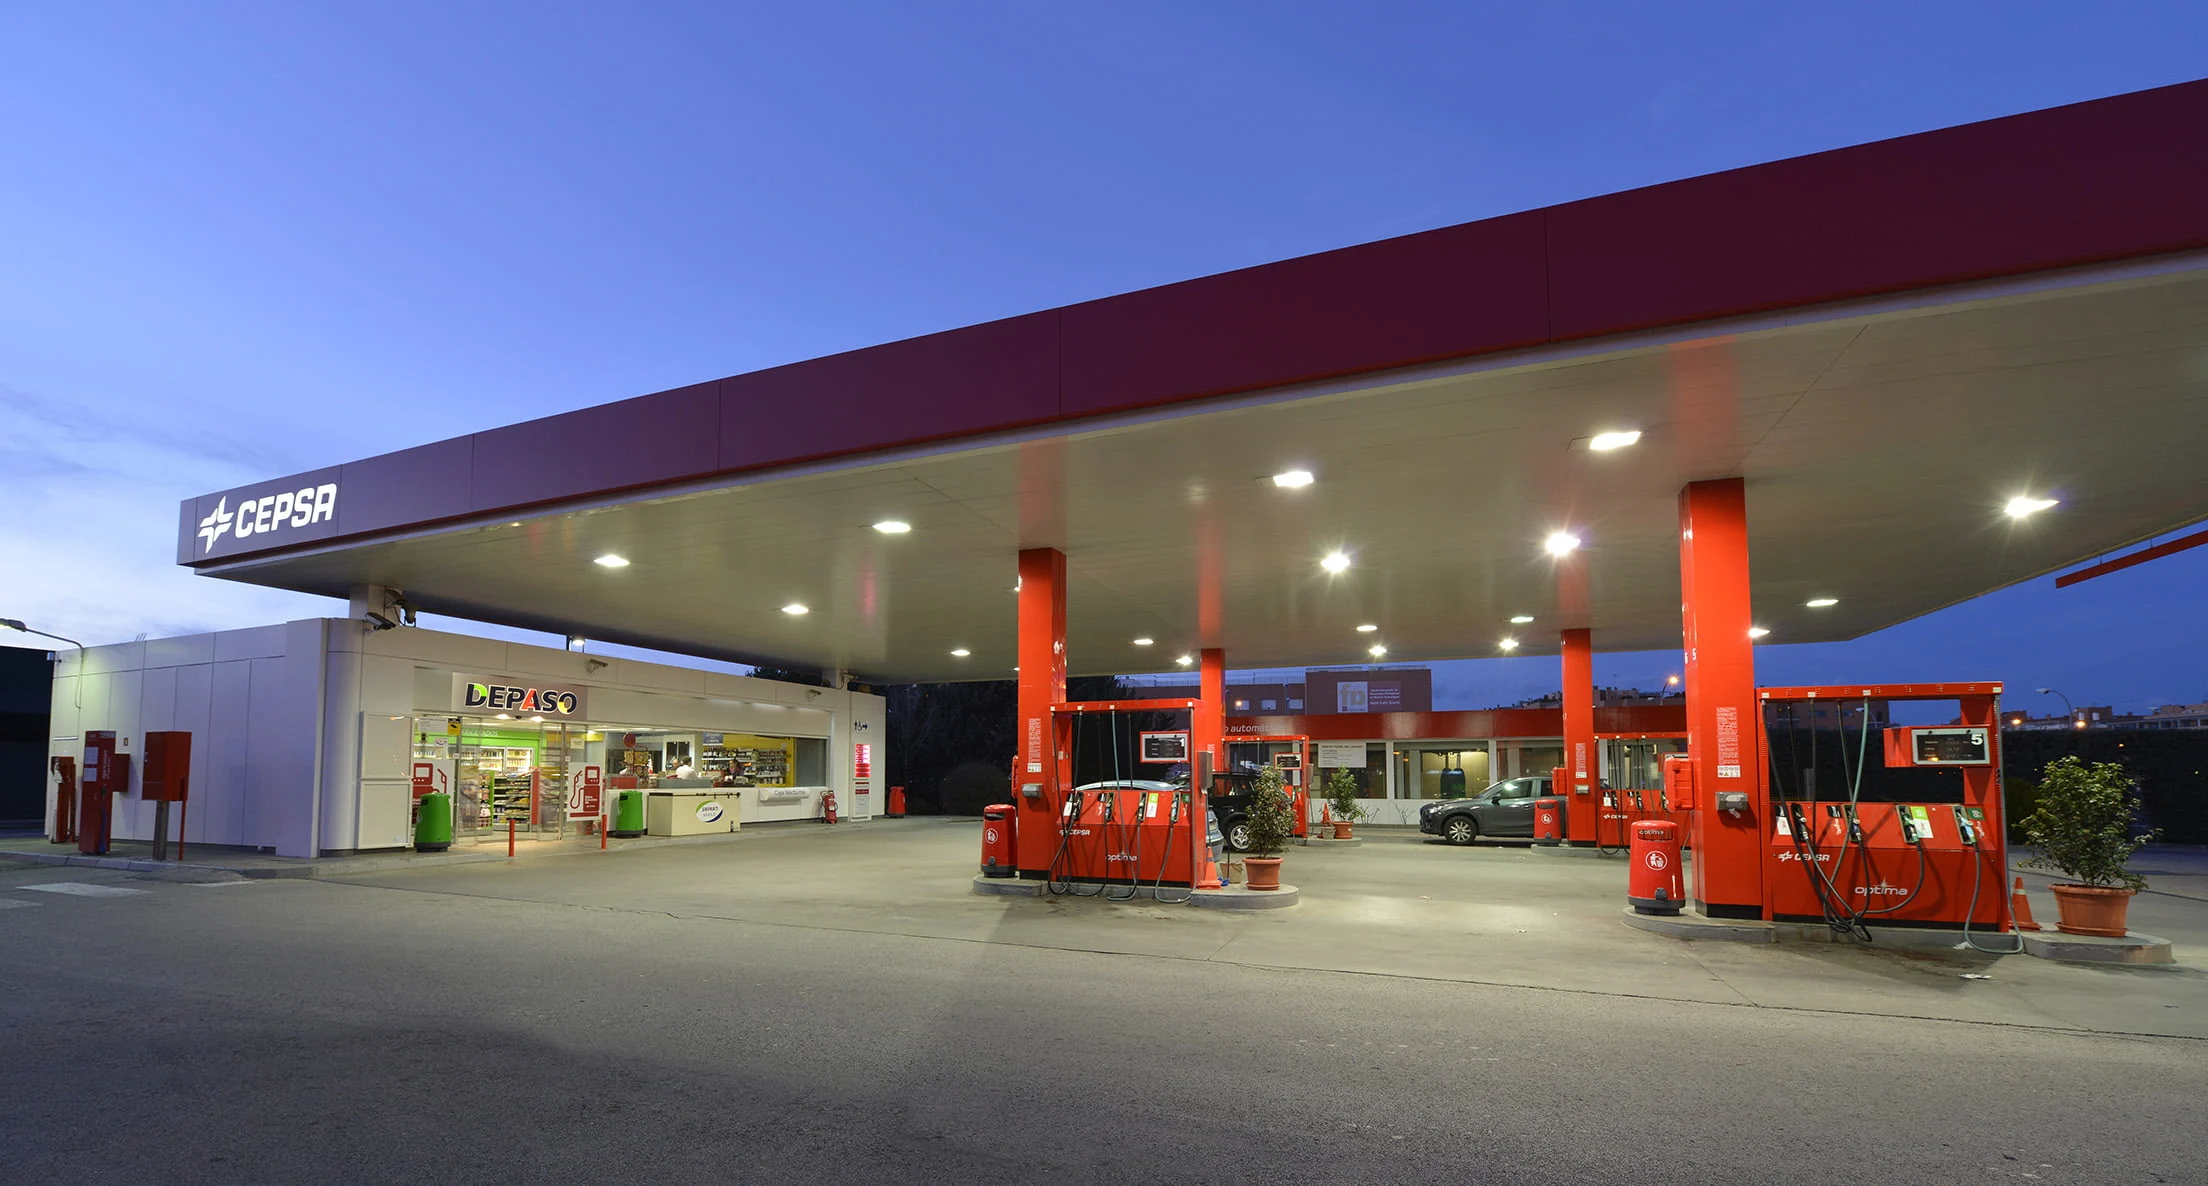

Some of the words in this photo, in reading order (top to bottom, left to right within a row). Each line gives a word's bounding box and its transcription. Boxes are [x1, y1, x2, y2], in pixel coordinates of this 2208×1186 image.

[235, 483, 337, 538] CEPSA
[464, 682, 578, 714] DEPASO
[1971, 734, 1983, 745] 5
[1854, 885, 1909, 897] optima
